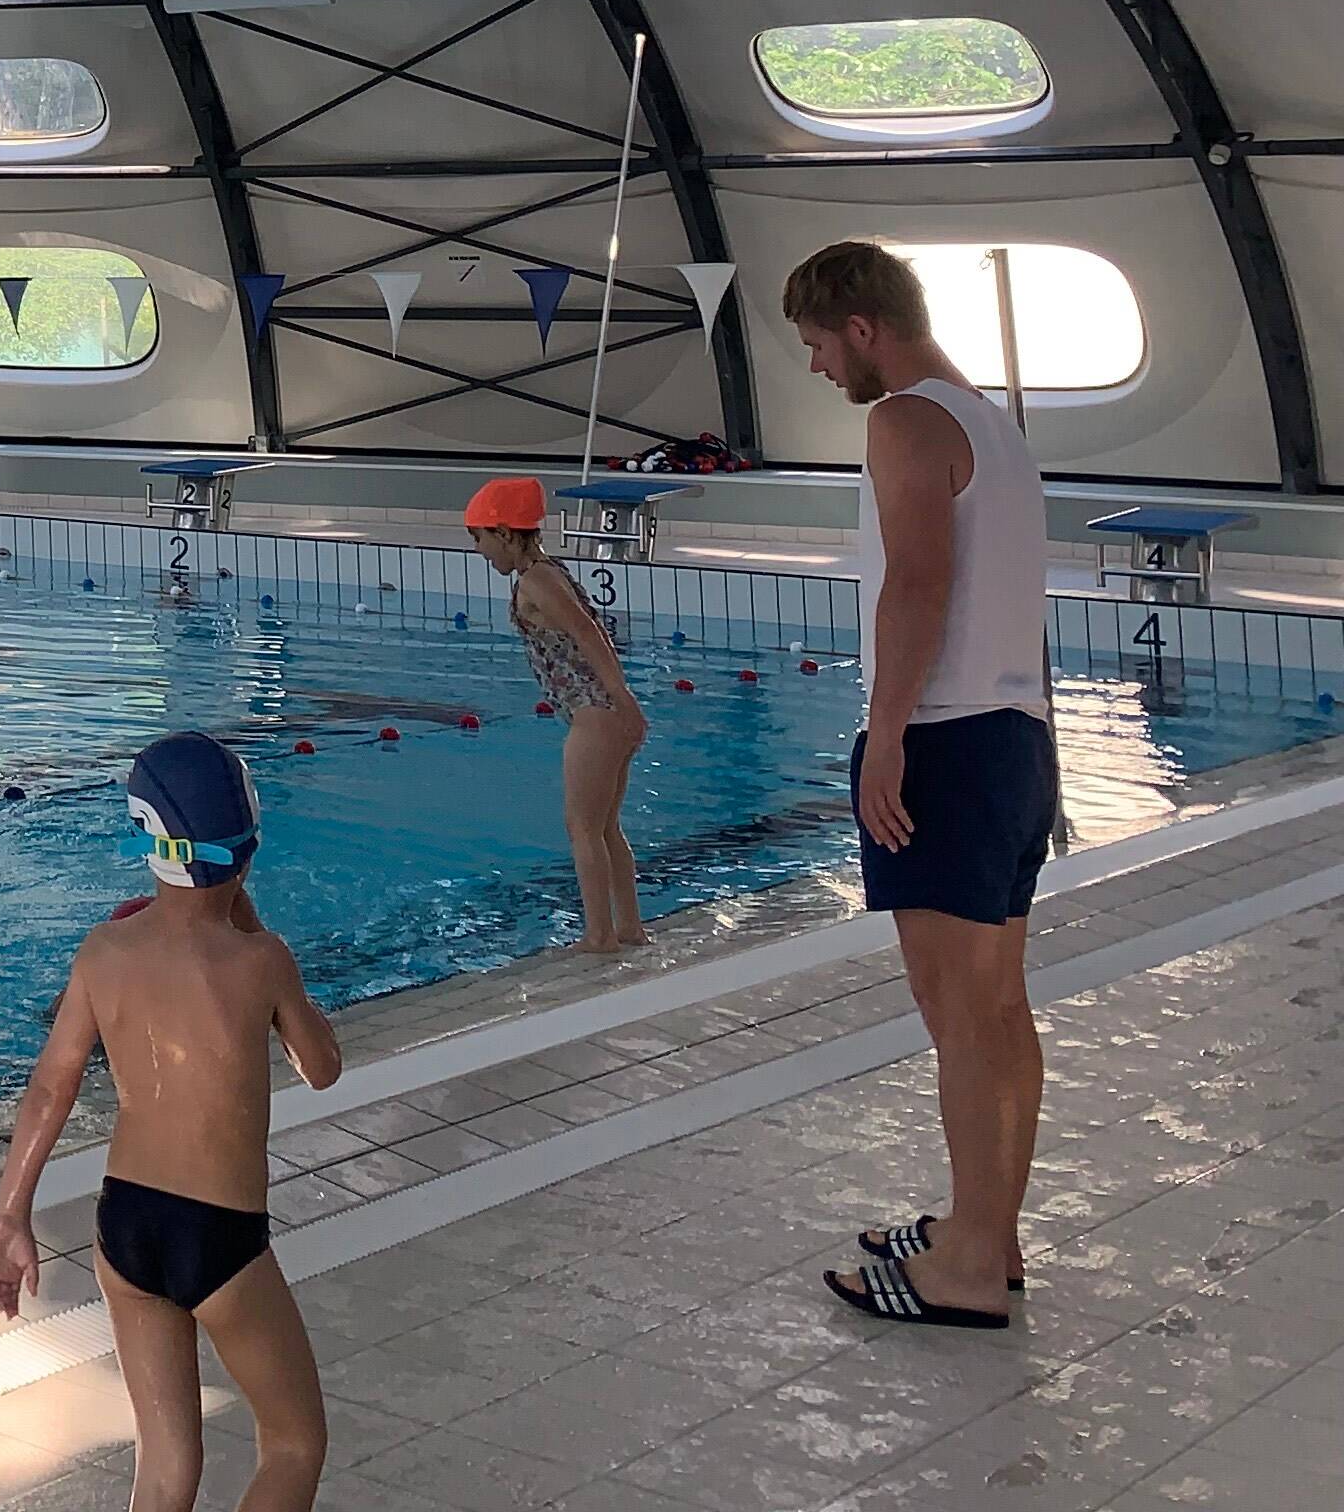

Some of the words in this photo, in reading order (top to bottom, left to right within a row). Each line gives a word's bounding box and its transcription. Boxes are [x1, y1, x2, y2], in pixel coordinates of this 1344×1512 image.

[182, 484, 196, 504] 2
[220, 489, 232, 510] 2
[603, 510, 618, 532] 3
[169, 535, 190, 570] 2
[1146, 544, 1167, 570] 4
[591, 568, 617, 607] 3
[1133, 612, 1167, 656] 4
